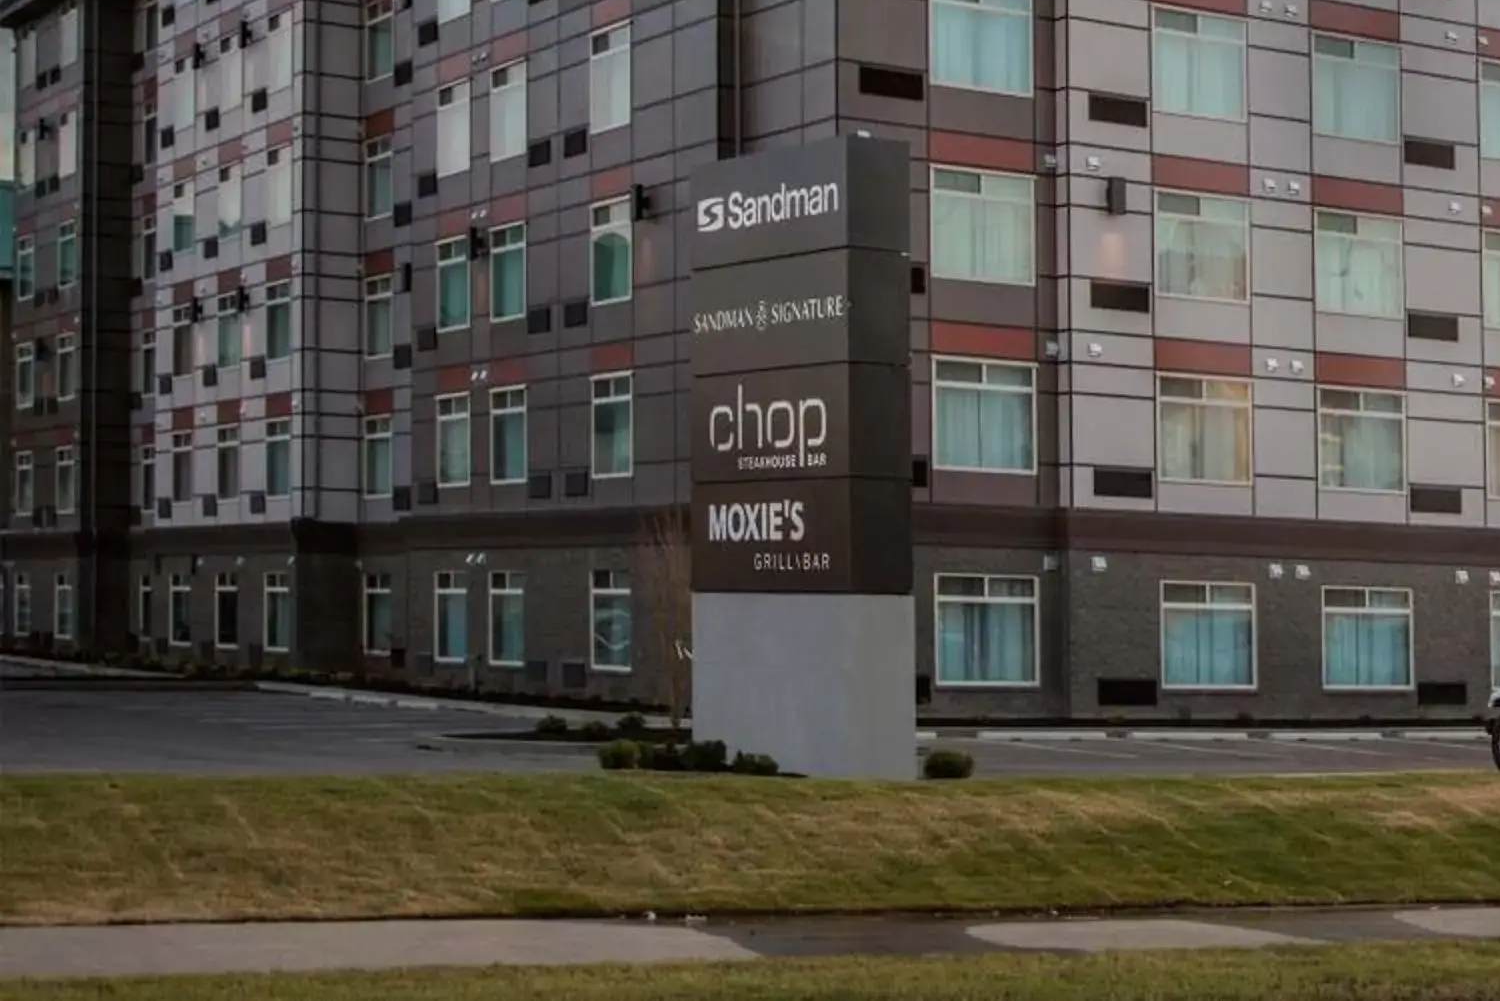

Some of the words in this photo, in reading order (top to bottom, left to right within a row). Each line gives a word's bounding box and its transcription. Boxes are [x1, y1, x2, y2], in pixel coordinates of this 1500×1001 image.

[728, 182, 839, 229] Sandman
[693, 307, 754, 334] SANDMAN
[770, 295, 844, 324] SIGNATURE
[709, 384, 827, 467] chop
[738, 454, 796, 470] STEAKHOUSE
[807, 453, 828, 467] BAR
[708, 499, 805, 542] MOXIE'S
